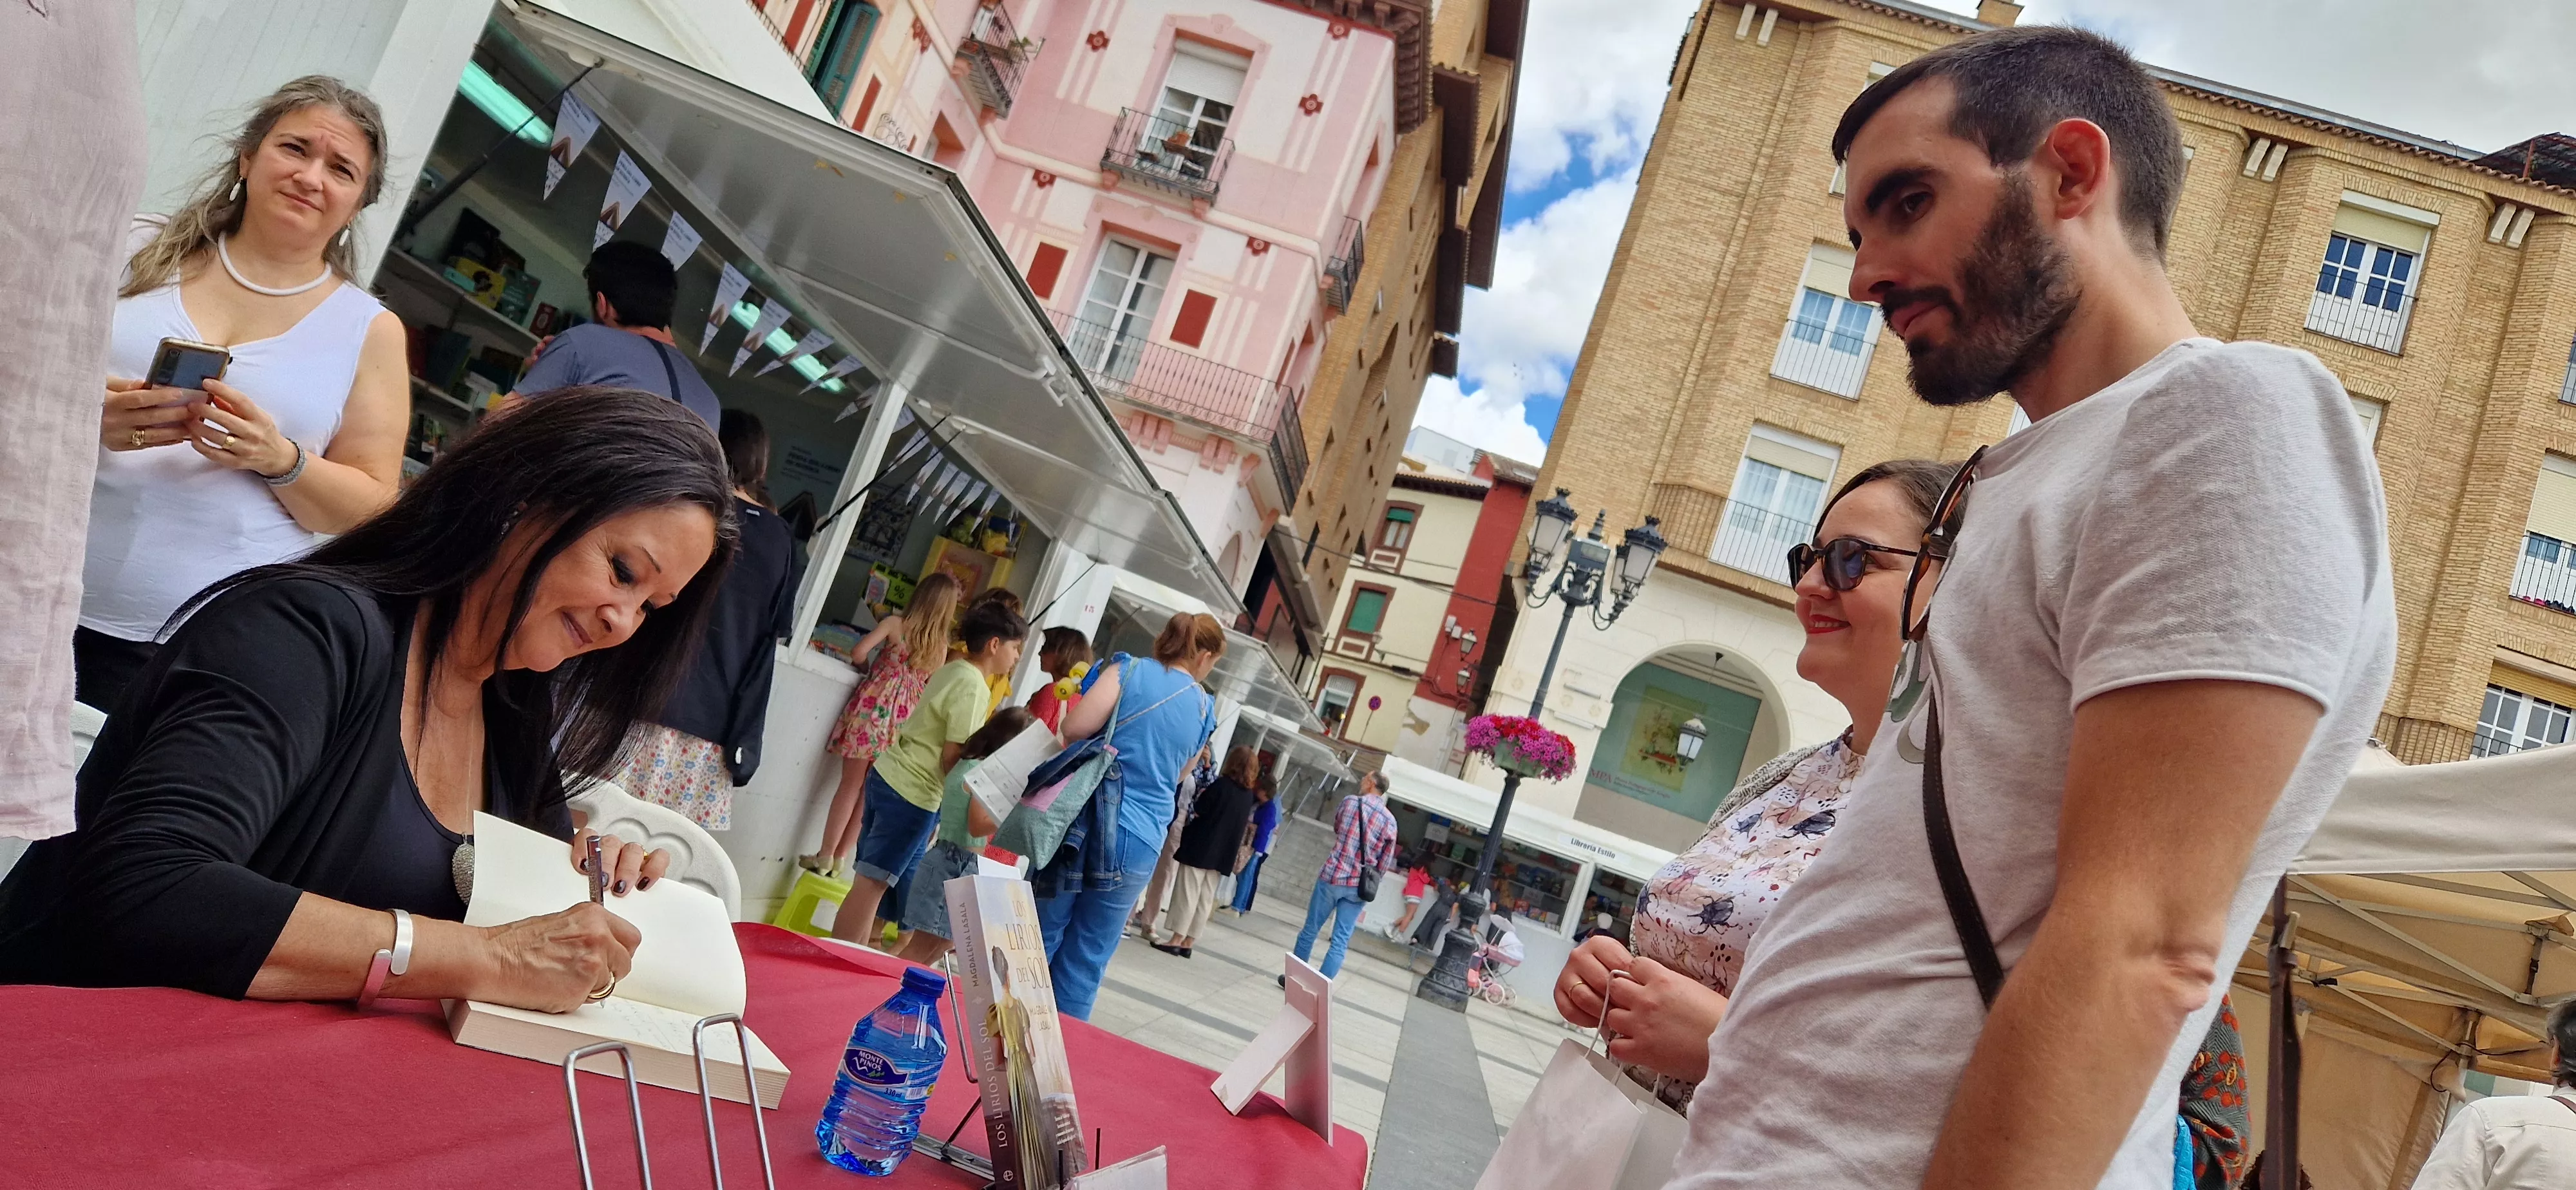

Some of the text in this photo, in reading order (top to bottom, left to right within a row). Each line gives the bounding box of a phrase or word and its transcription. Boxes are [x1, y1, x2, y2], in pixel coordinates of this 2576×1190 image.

[1597, 847, 1615, 859] Estilo
[1012, 900, 1027, 917] LOS
[959, 902, 979, 987] MAGDALENA LASALA
[1005, 923, 1042, 951] LIRIOS
[1016, 956, 1050, 989] DEL SOL
[858, 1050, 884, 1066] MONTE
[859, 1057, 882, 1071] PINOS
[978, 1019, 1008, 1148] LOS LIRIOS DEL SOL
